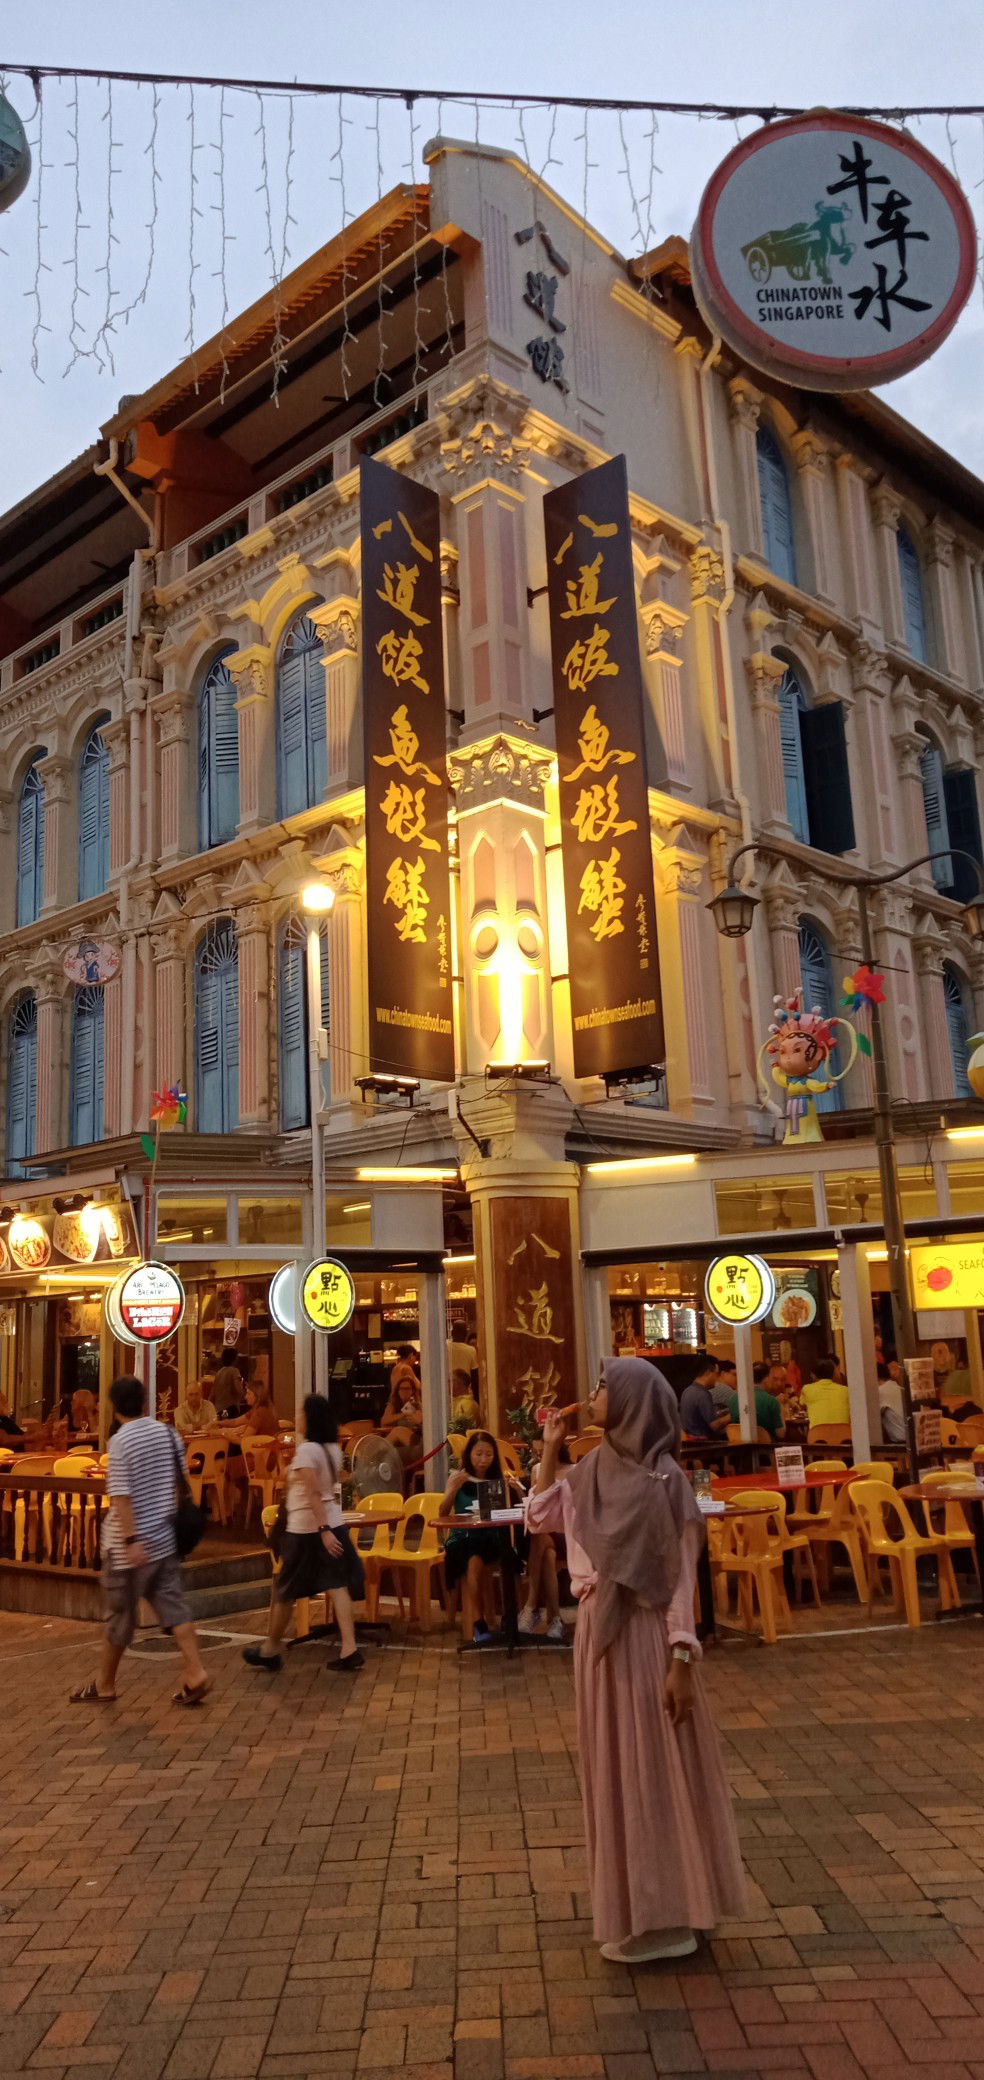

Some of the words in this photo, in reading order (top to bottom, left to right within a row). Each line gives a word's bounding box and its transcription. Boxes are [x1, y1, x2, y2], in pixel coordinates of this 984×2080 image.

[826, 141, 932, 332] 牛车水
[757, 286, 843, 302] CHINATOWN
[758, 305, 844, 321] SINGAPORE
[376, 1005, 452, 1034] www.chinatownseafood.com
[574, 998, 656, 1031] www.chinatownseafood.com
[891, 1245, 899, 1260] 7
[317, 1271, 342, 1317] 點心
